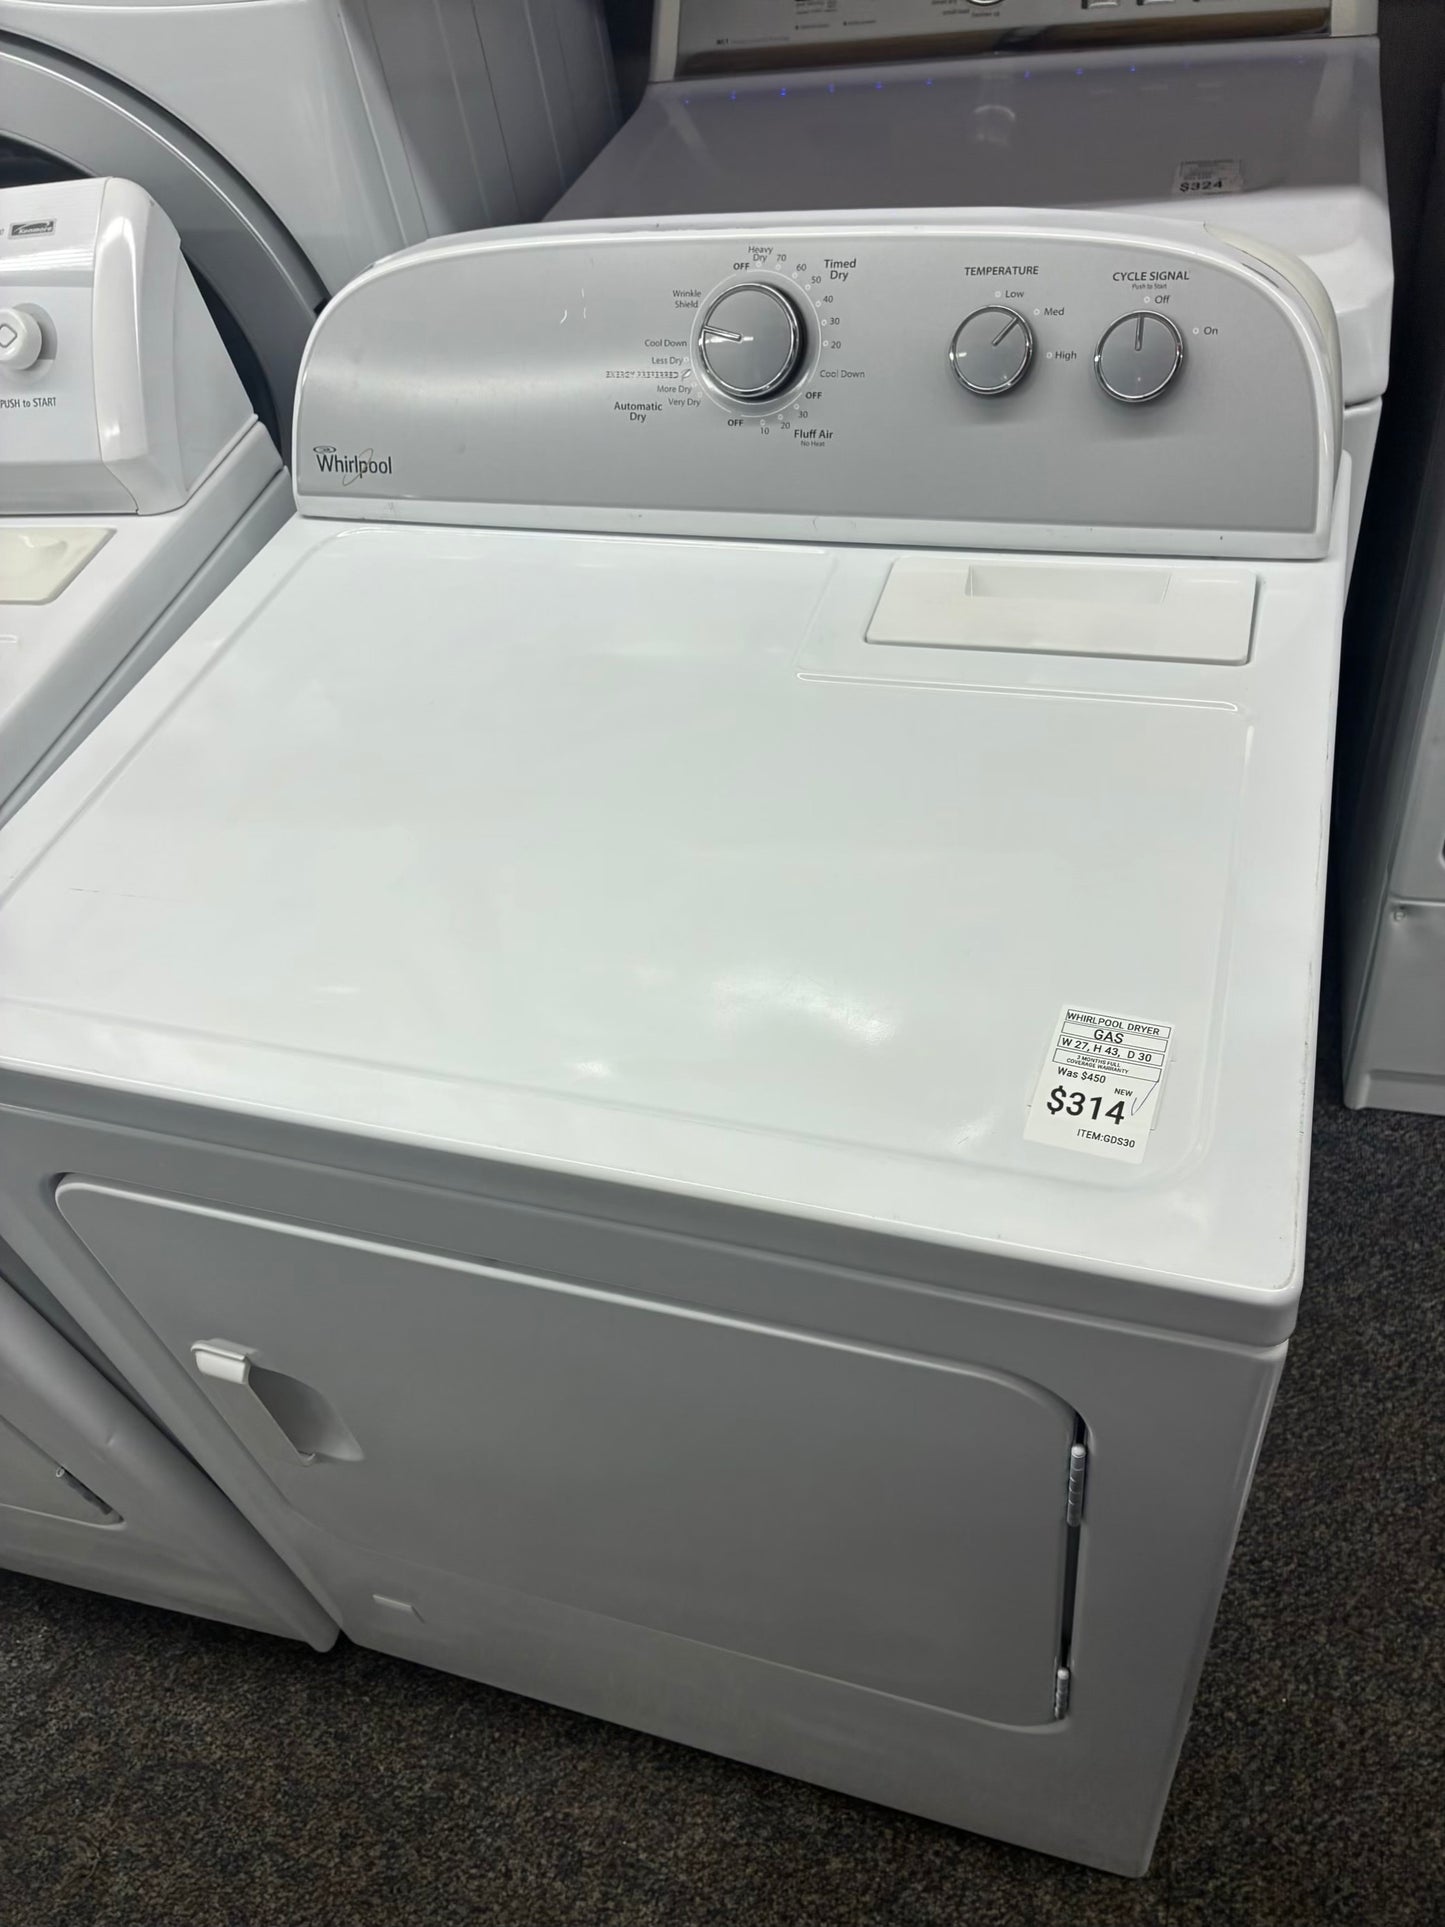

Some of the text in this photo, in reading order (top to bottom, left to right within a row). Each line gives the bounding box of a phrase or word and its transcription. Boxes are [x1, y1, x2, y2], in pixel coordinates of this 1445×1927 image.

[1180, 181, 1222, 192] $324
[748, 246, 773, 255] Heavy
[753, 254, 767, 262] Dry
[777, 254, 787, 262] 70
[733, 262, 750, 270] OFF
[824, 259, 857, 269] Timed
[830, 270, 849, 282] Dry
[964, 266, 1040, 276] TEMPERATURE
[1112, 271, 1190, 281] CYCLE SIGNAL
[811, 276, 821, 284] 50
[672, 289, 702, 298] Wrinkle
[1005, 290, 1025, 298] Low
[823, 295, 834, 303] 40
[1154, 295, 1170, 304] Off
[675, 300, 699, 309] Shield
[1044, 307, 1065, 316] Med
[829, 317, 840, 325] 30
[1203, 326, 1218, 335] On
[644, 339, 687, 347] Cool Down
[831, 341, 841, 349] 20
[651, 356, 684, 366] Less Dry
[1055, 351, 1077, 361] High
[819, 369, 865, 378] Cool Down
[657, 385, 692, 395] More Dry
[805, 391, 822, 400] OFF
[22, 399, 31, 408] to
[32, 396, 56, 408] START
[614, 401, 663, 411] Automatic
[668, 398, 701, 408] Very Dry
[629, 411, 647, 423] Dry
[799, 411, 809, 419] 30
[727, 418, 744, 427] OFF
[781, 422, 791, 430] 20
[760, 427, 770, 435] 10
[794, 429, 834, 439] Fluff Air
[316, 454, 393, 479] Whirlpool
[1067, 1011, 1161, 1036] WHIRLPOOL DRYER
[1094, 1029, 1125, 1045] GAS
[1062, 1037, 1153, 1063] W 27, H 43, D 30
[1066, 1057, 1130, 1075] COVERAGE WARRANTY
[1081, 1056, 1106, 1066] MONTHS
[1057, 1066, 1107, 1084] Was $450
[1113, 1087, 1134, 1097] NEW
[1046, 1084, 1126, 1126] $314
[1077, 1128, 1136, 1149] ITEM:GDS30
